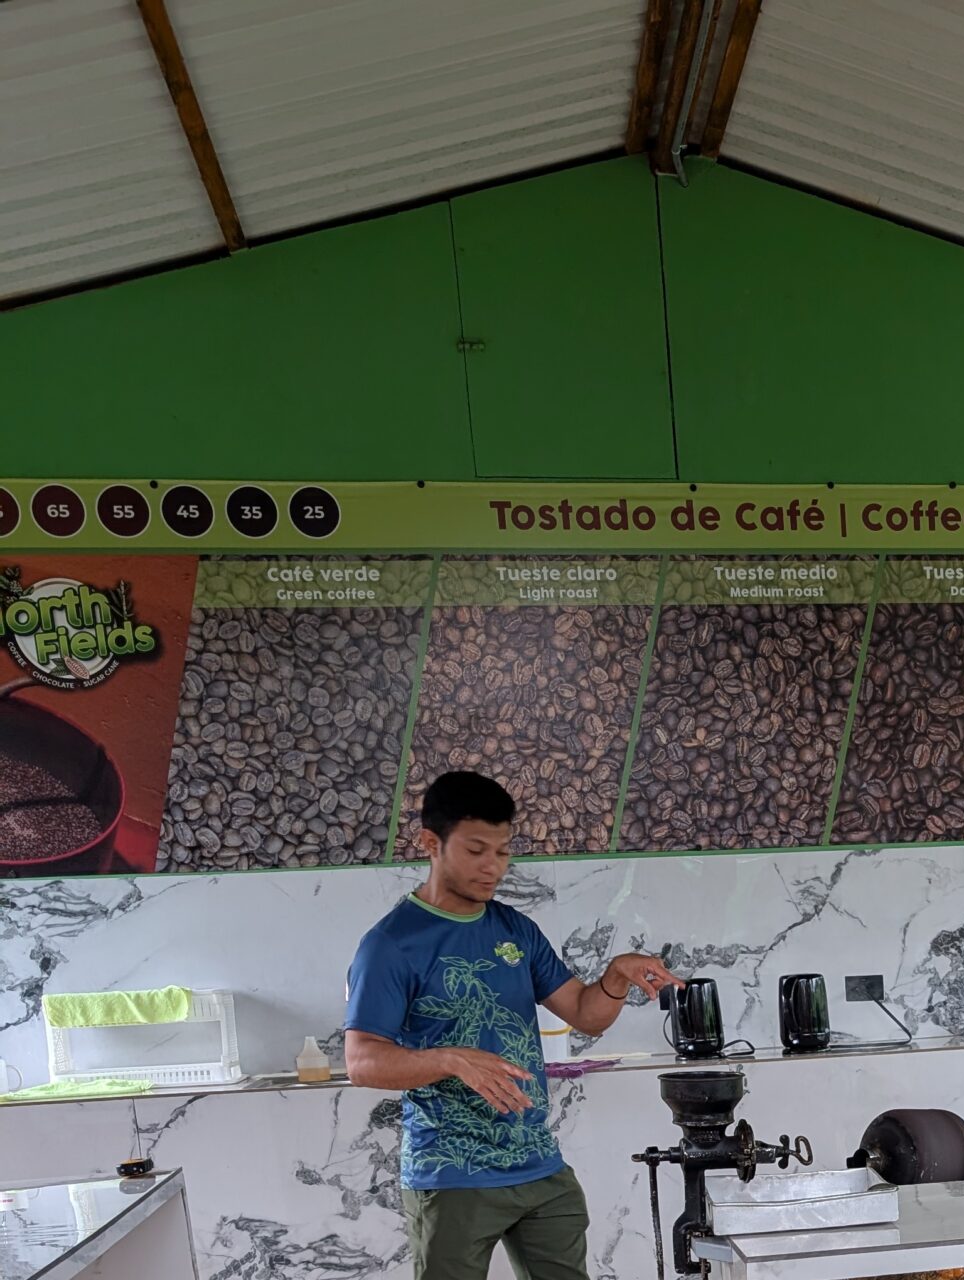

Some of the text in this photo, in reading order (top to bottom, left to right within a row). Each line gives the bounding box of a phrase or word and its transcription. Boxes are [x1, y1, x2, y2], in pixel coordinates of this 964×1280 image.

[46, 504, 70, 518] 65
[112, 505, 135, 519] 55
[176, 505, 200, 519] 45
[240, 506, 263, 520] 35
[303, 506, 325, 519] 25
[489, 499, 656, 531] Tostado
[670, 499, 721, 531] de
[735, 498, 825, 531] Café
[267, 565, 381, 582] Café verde
[496, 566, 617, 581] Tueste claro
[714, 565, 838, 580] Tueste medio
[276, 588, 376, 600] Green coffee
[519, 587, 599, 601] Light roast
[730, 585, 824, 597] Medium roast
[0, 585, 112, 635] orth
[34, 620, 155, 665] Fields
[7, 641, 120, 689] COFFEE CHOCOLATE SUGAR CANE
